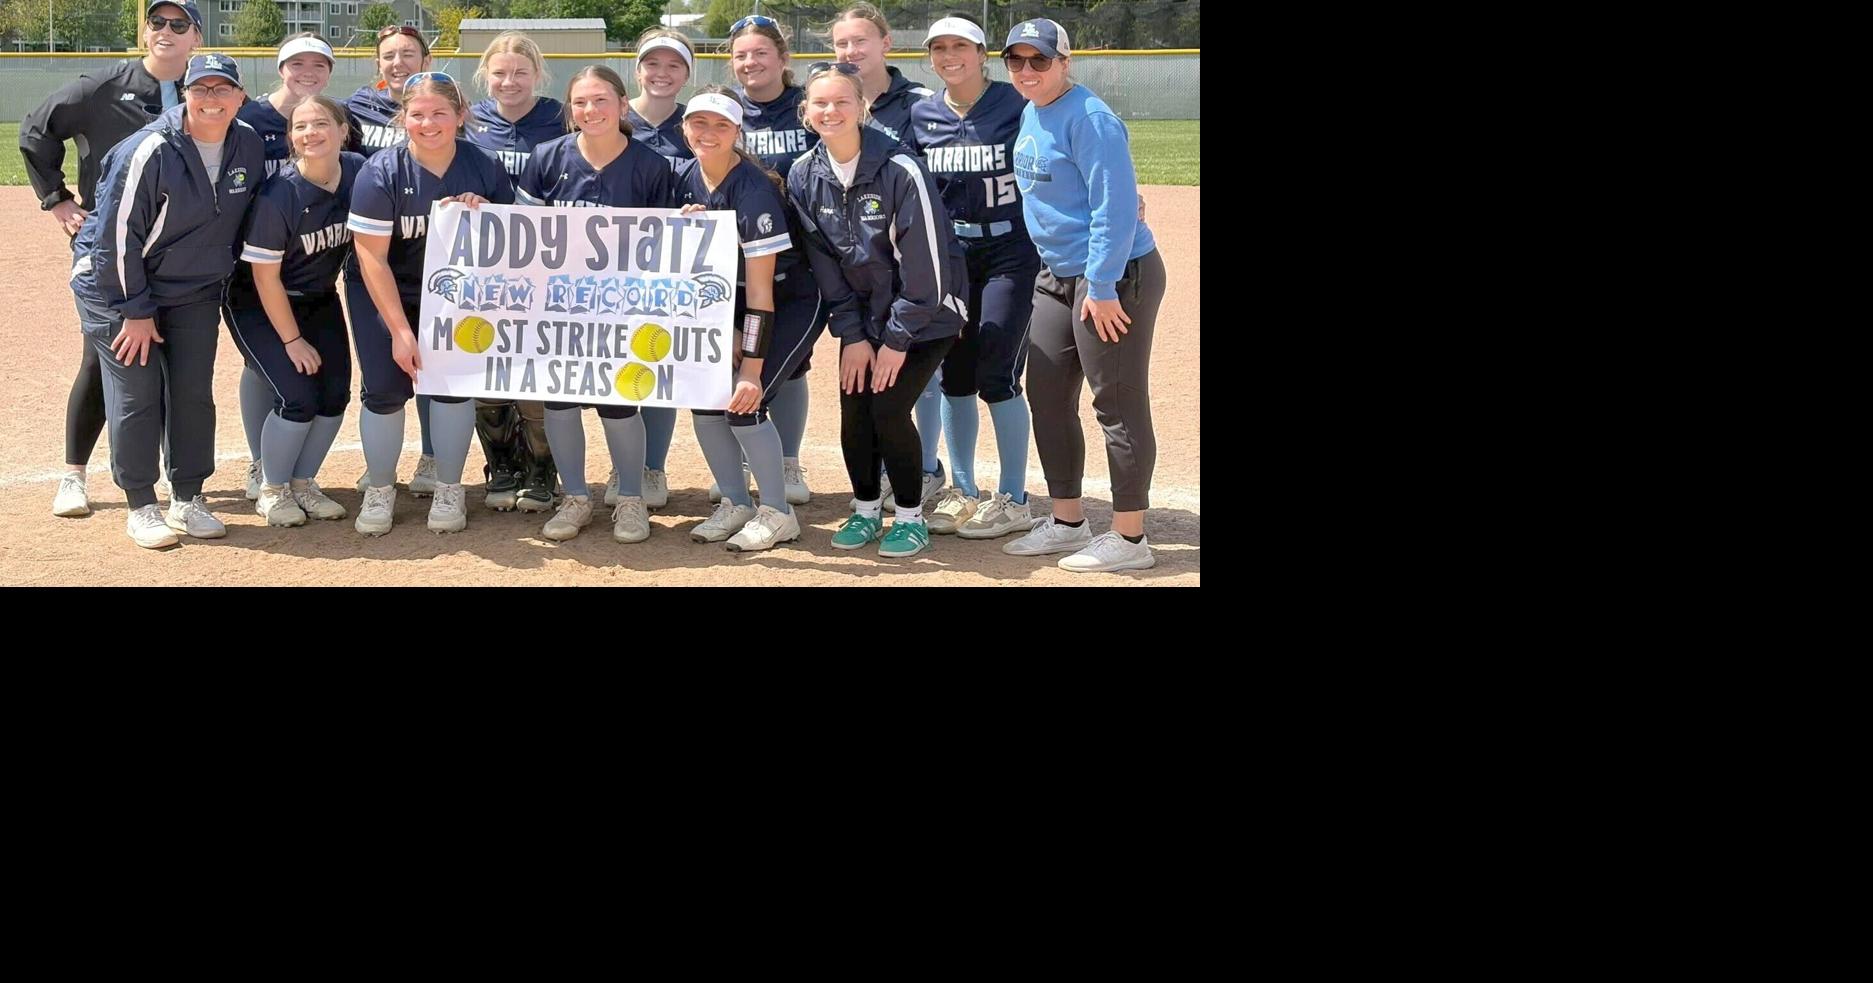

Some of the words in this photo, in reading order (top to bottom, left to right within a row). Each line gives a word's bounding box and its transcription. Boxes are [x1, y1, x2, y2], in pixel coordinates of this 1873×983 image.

[982, 173, 1017, 208] 15
[462, 279, 532, 304] NEW
[552, 284, 694, 309] RECORD
[484, 356, 512, 392] IN
[519, 358, 537, 392] A
